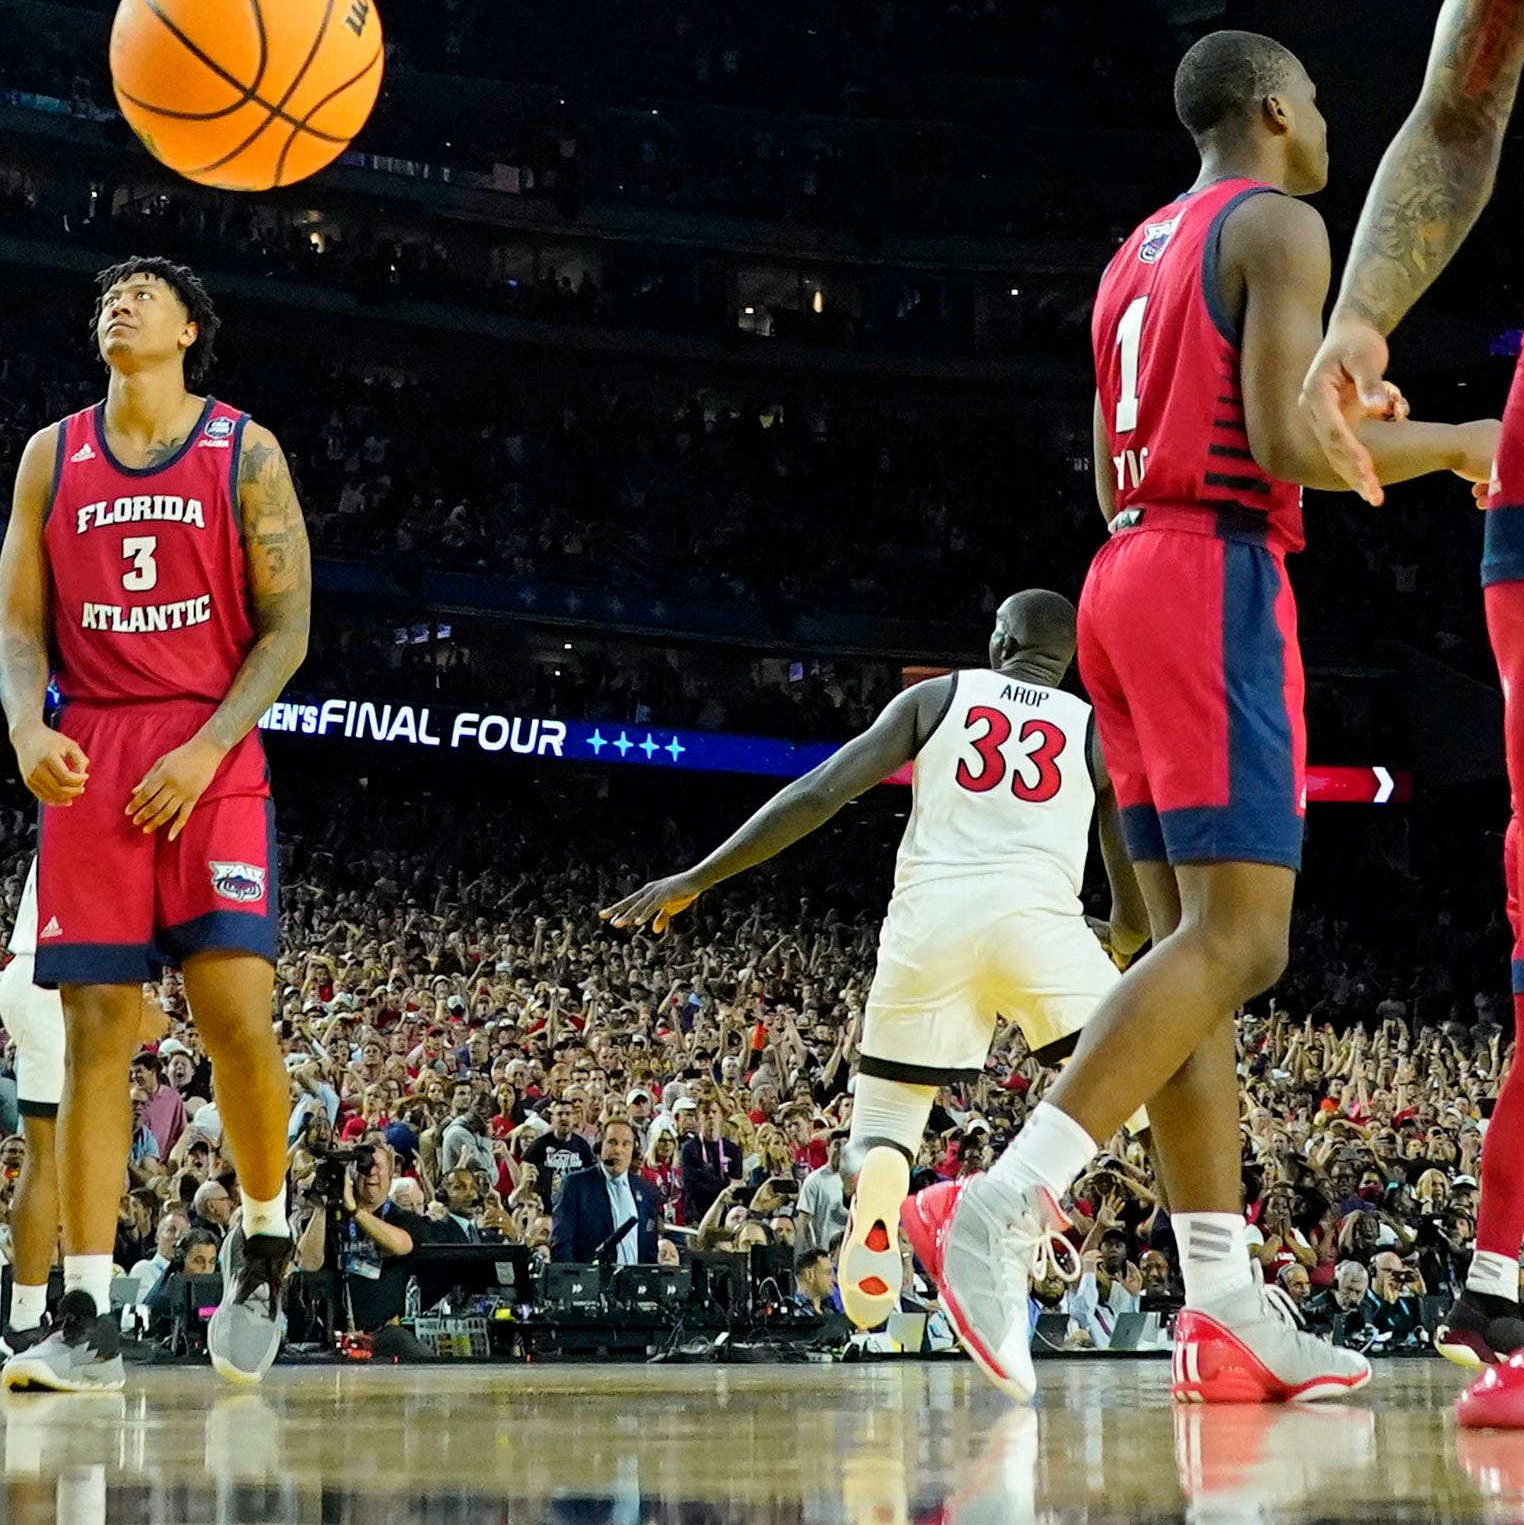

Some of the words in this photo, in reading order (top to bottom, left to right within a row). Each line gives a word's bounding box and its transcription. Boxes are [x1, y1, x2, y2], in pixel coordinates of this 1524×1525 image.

[1114, 294, 1149, 434] 1
[77, 494, 206, 535] FLORIDA
[121, 535, 158, 592] 3
[81, 594, 211, 633] ATLANTIC
[999, 683, 1050, 708] AROP
[318, 699, 442, 746] FINAL
[450, 711, 568, 757] FOUR
[955, 704, 1068, 804] 33
